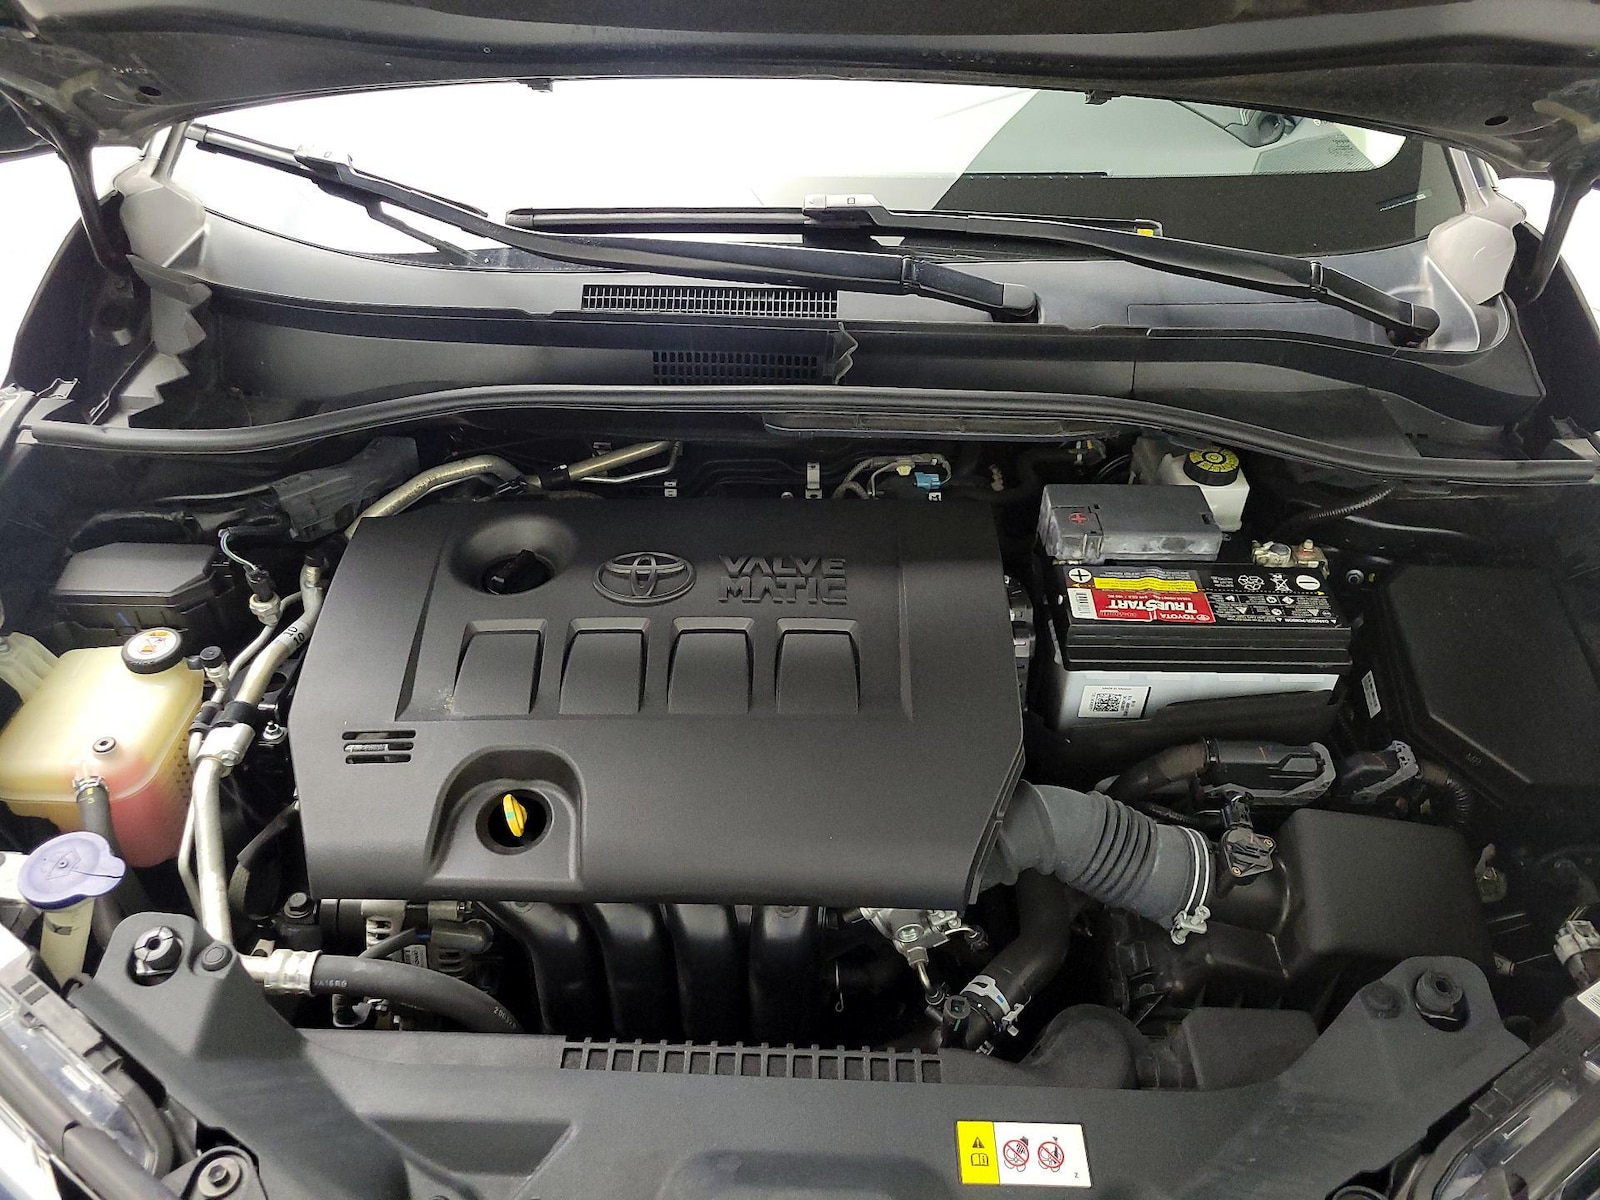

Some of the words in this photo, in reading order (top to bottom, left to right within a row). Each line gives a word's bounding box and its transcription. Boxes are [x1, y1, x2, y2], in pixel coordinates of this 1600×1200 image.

[718, 554, 846, 578] VALVE
[717, 576, 848, 605] MATIC
[1110, 599, 1198, 614] TRUESTART
[293, 632, 306, 647] 10
